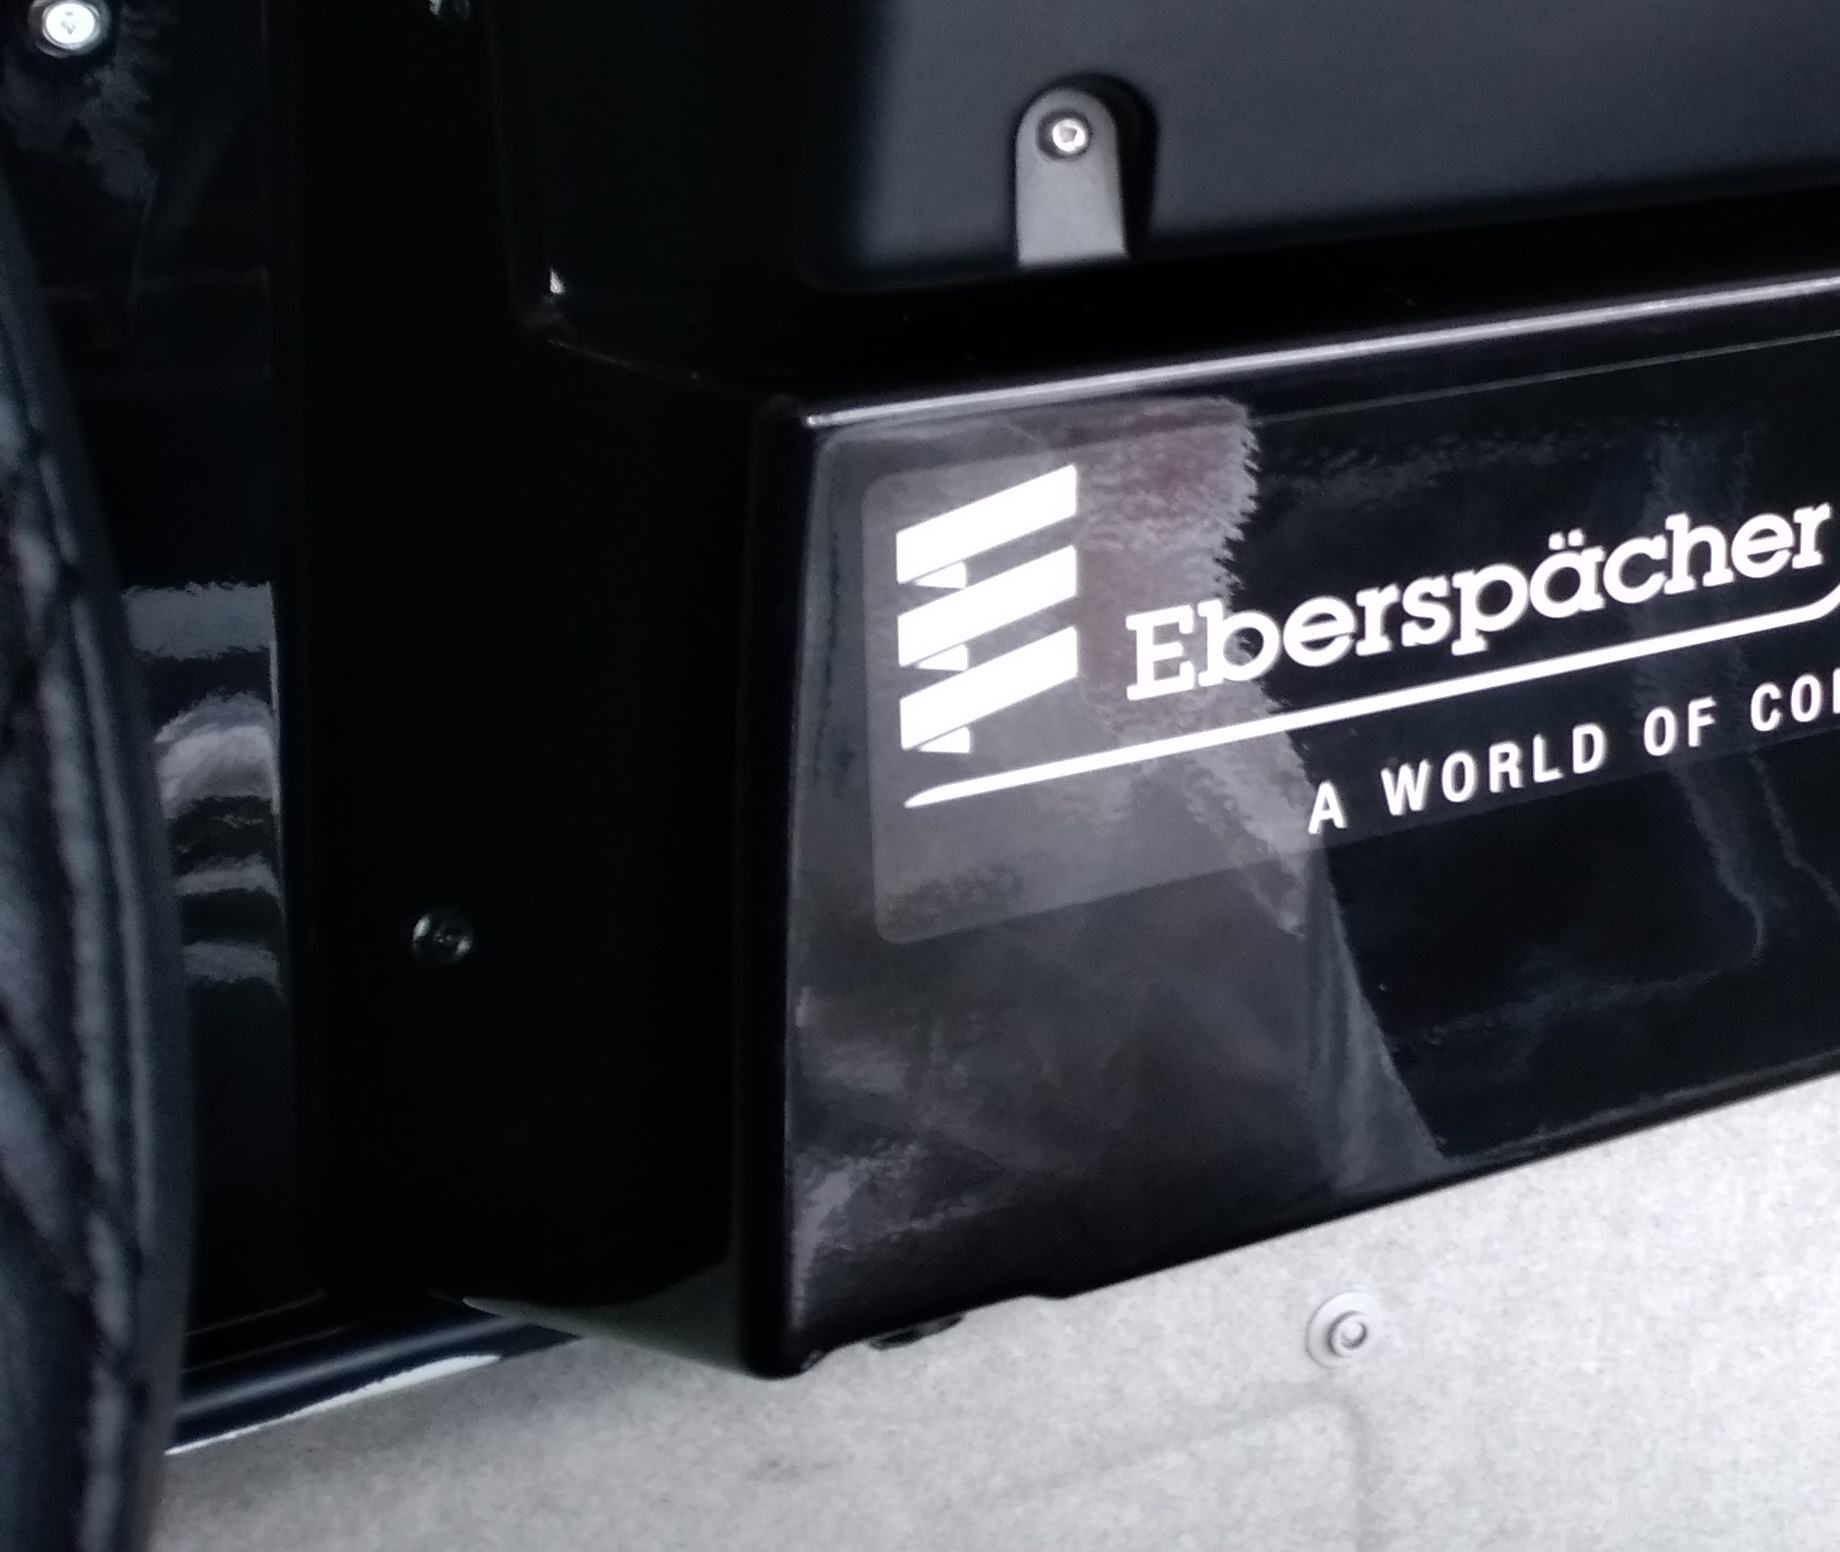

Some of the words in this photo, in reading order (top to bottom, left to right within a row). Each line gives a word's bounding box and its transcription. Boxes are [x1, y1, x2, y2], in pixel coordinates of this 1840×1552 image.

[1124, 501, 1832, 701] Eberspächer
[1308, 780, 1348, 835] A
[1380, 723, 1606, 816] WORLD
[1643, 696, 1718, 757] OF
